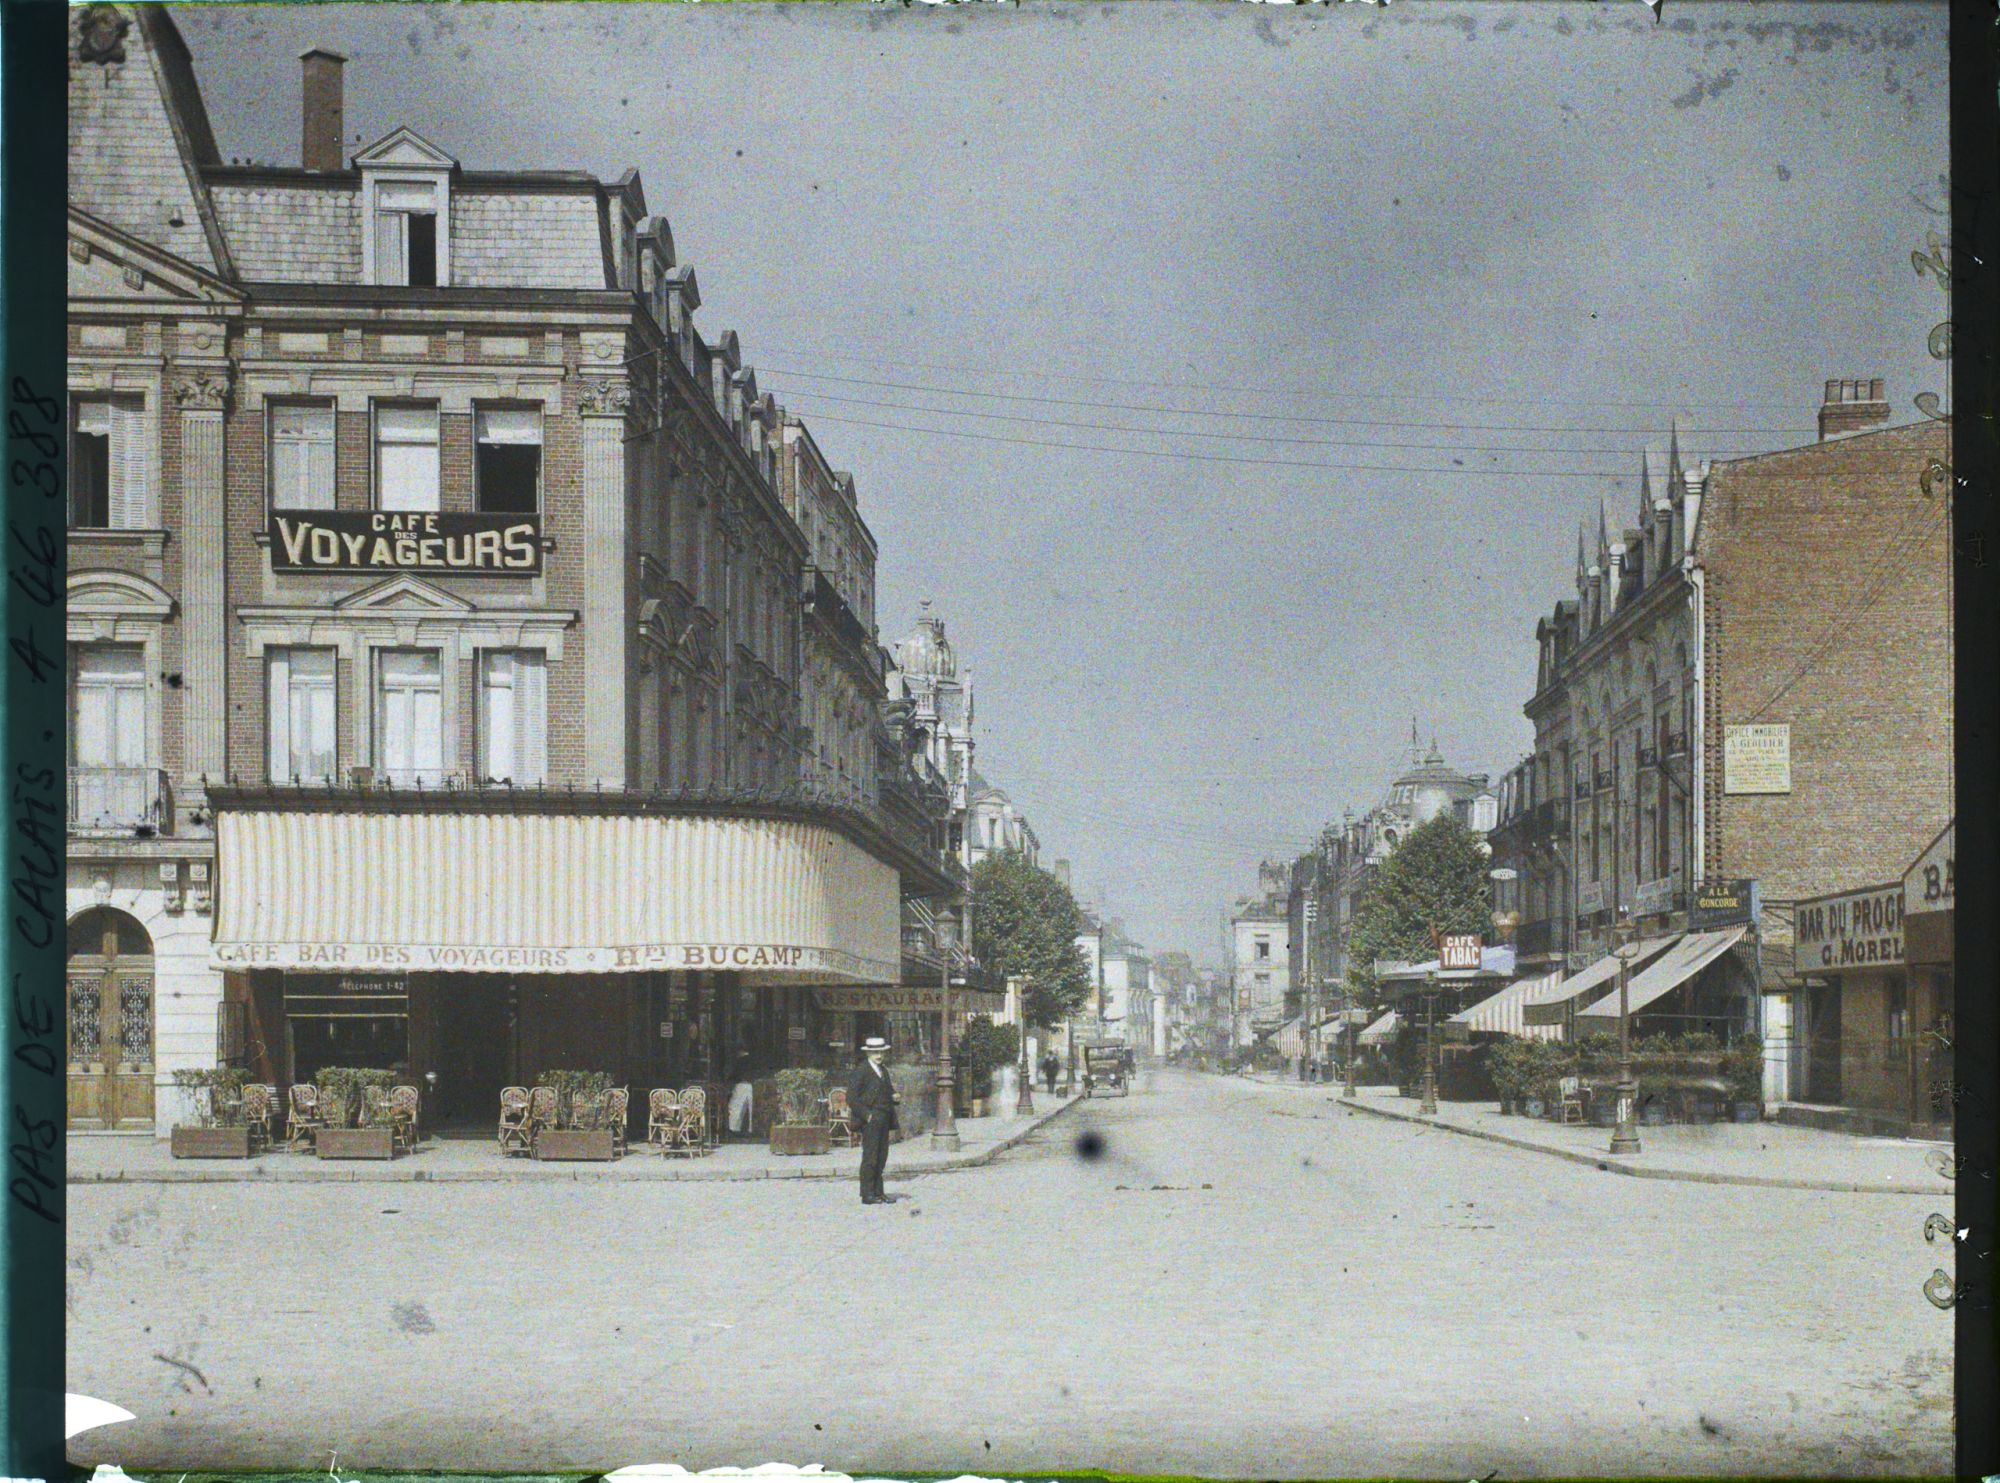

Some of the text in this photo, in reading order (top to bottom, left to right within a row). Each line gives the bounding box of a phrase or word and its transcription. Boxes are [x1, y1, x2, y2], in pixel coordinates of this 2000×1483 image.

[9, 375, 60, 500] 388
[275, 516, 536, 568] VOYAGEURS
[9, 623, 58, 684] A
[1799, 907, 1824, 942] BAR
[1829, 902, 1846, 940] DU
[299, 945, 347, 962] BAR
[367, 945, 410, 963] DES
[429, 948, 568, 966] VOYAGEURS
[683, 946, 802, 966] BUCAMP
[1442, 947, 1479, 966] TABAC
[13, 973, 58, 1076] DE
[10, 1104, 60, 1224] PAS
